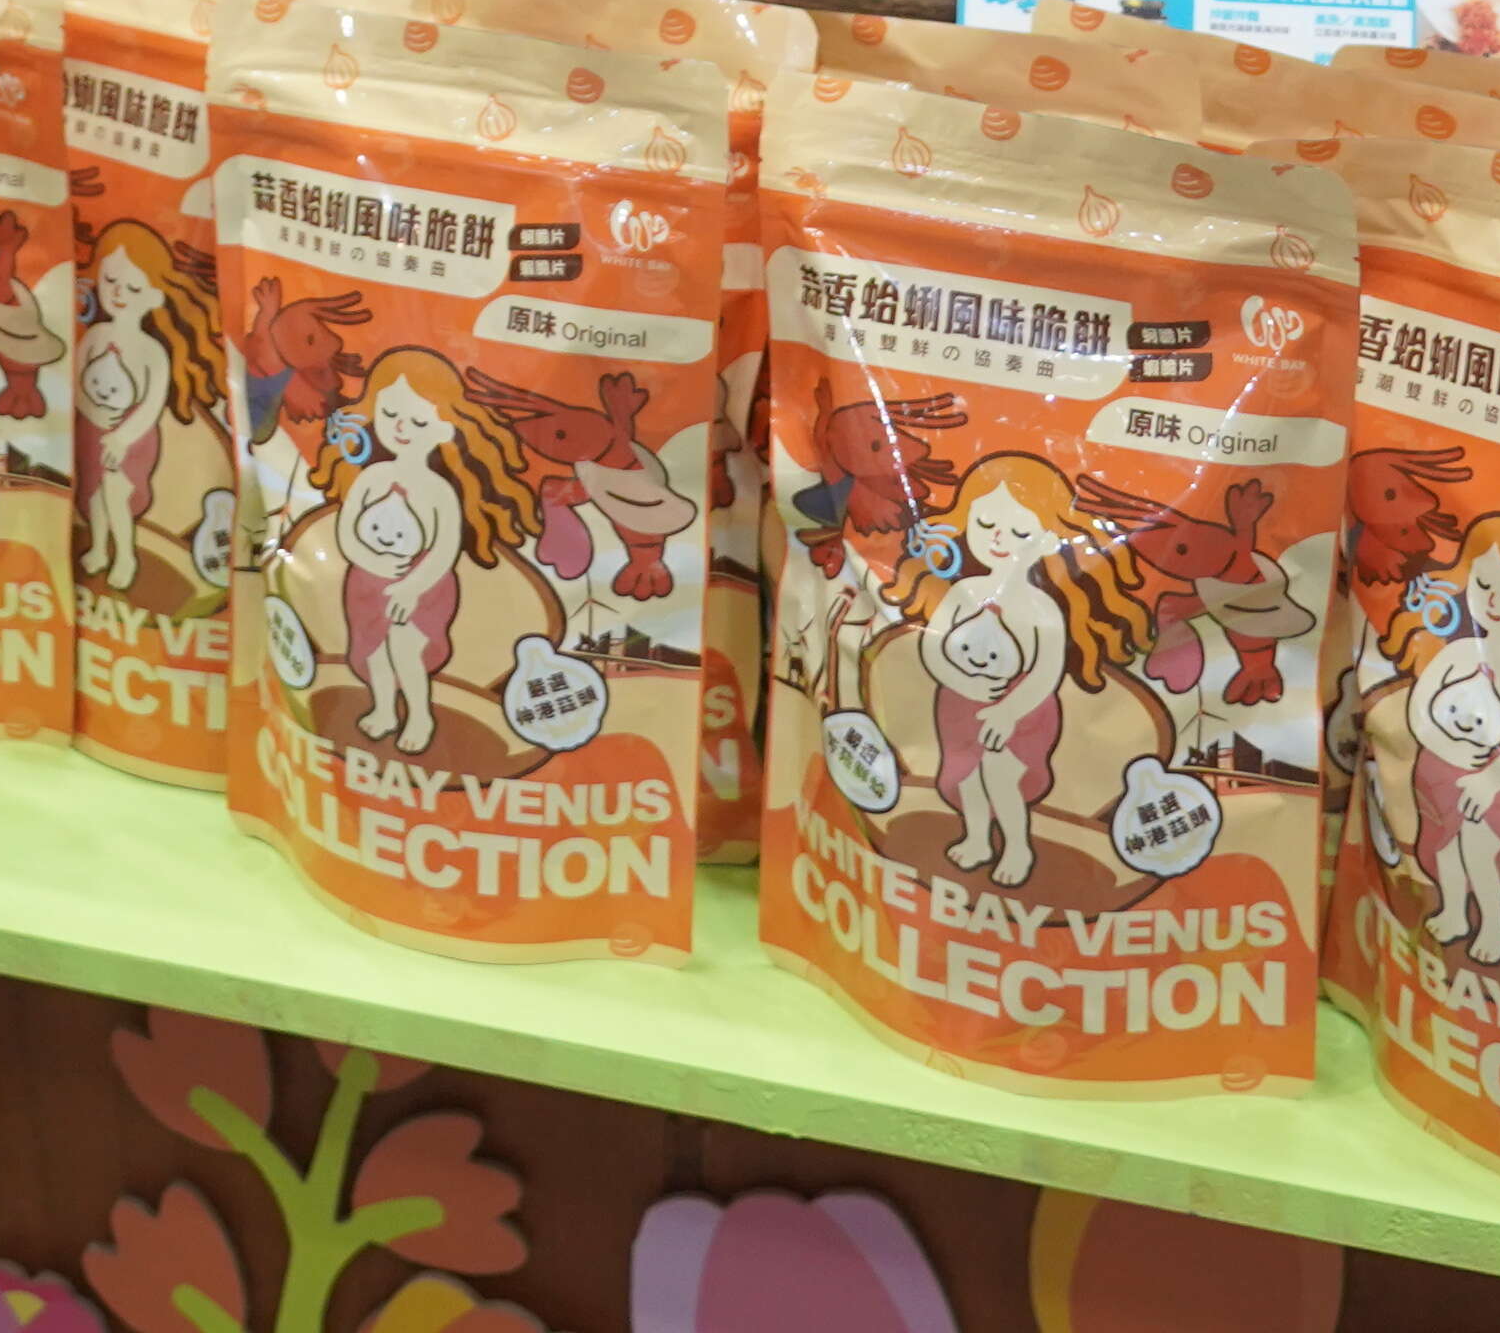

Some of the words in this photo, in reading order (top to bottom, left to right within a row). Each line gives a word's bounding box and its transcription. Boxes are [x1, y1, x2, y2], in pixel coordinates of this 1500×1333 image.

[250, 170, 496, 260] 蒜香蛤蜊風味脆餅
[505, 305, 557, 338] 原味
[561, 322, 647, 349] Original
[799, 263, 1112, 358] 蒜香蛤蜊風味脆餅
[1232, 352, 1276, 369] WHITE
[1125, 408, 1182, 445] 原味
[1187, 424, 1278, 455] Original
[344, 745, 454, 812] BAY
[460, 774, 672, 827] VENUS
[791, 853, 1287, 1036] COLLECTION
[929, 876, 1053, 949] BAY
[1064, 900, 1288, 957] VENUS
